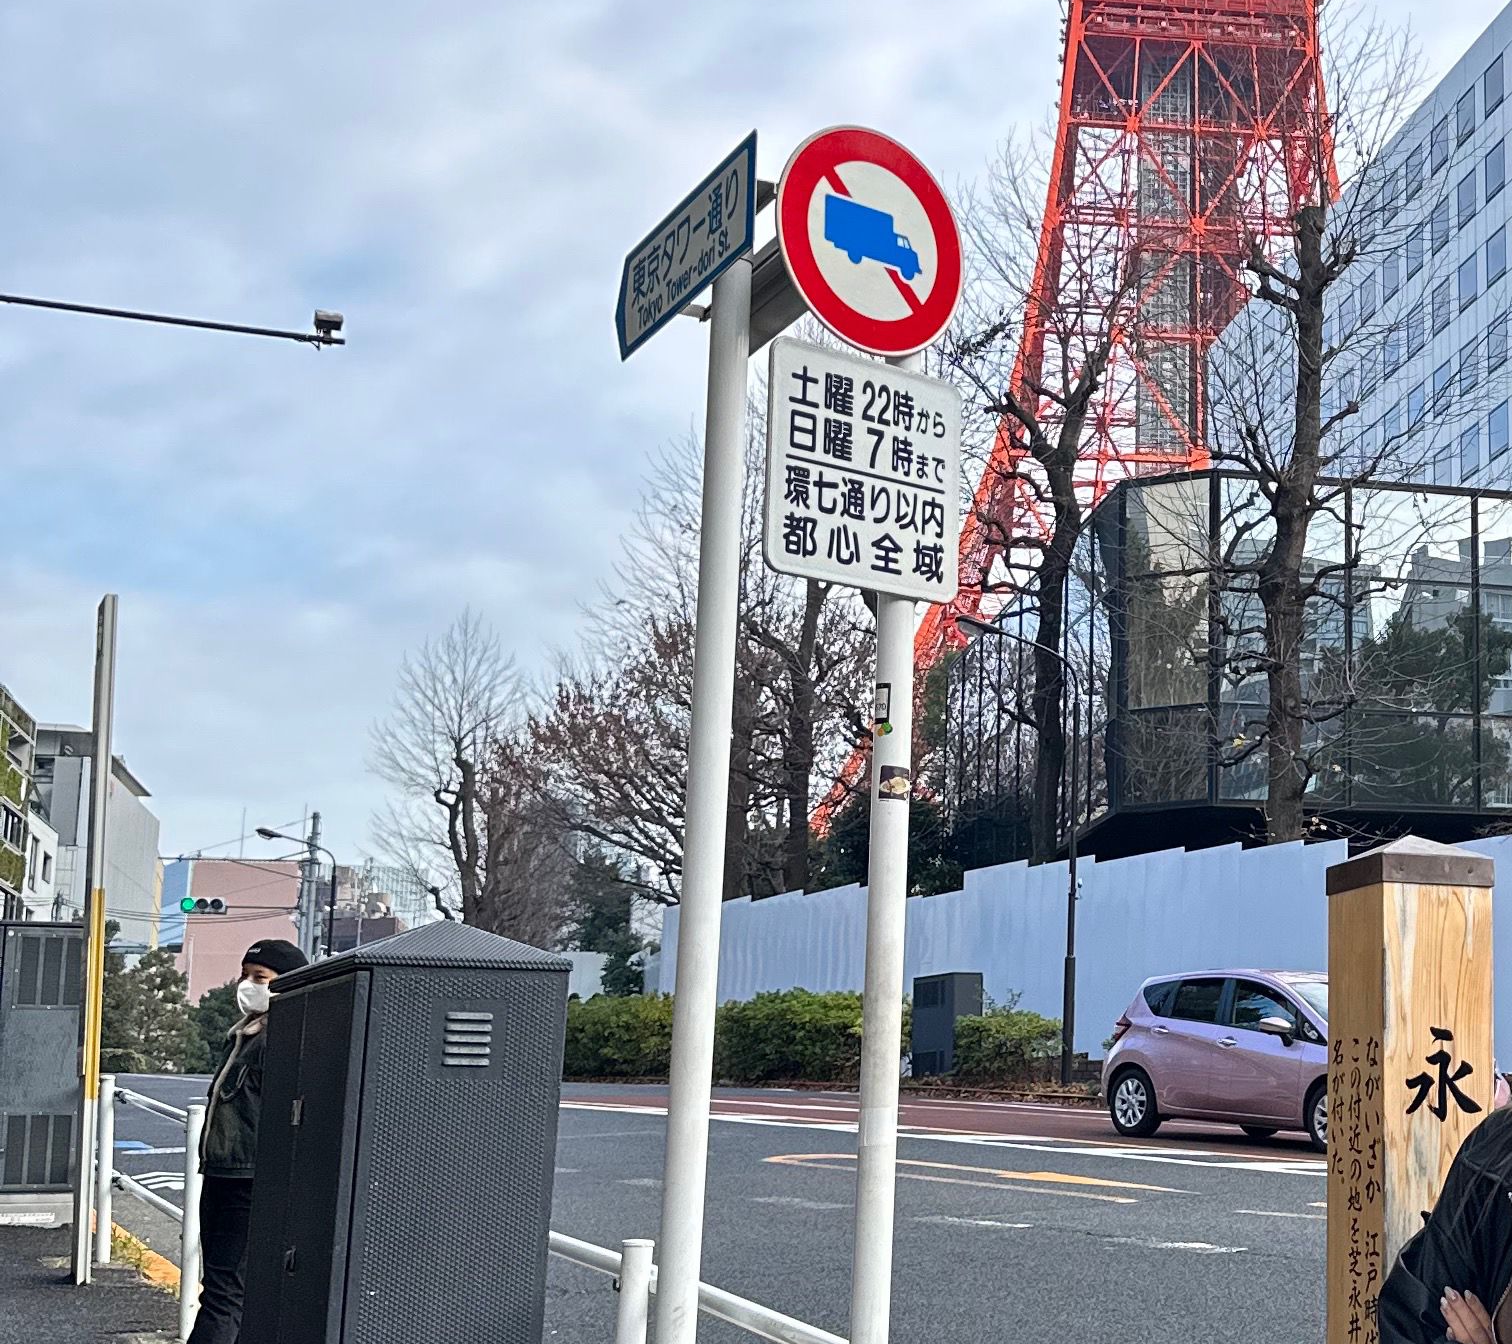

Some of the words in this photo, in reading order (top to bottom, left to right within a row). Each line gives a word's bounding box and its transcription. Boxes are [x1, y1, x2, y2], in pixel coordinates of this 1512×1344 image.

[632, 169, 738, 308] 東京タワー通り
[637, 293, 663, 329] Tokyo
[666, 238, 715, 304] Tower-dori
[719, 226, 731, 255] St.
[784, 464, 945, 539] 環七通り以内
[1331, 1039, 1345, 1184] 名が付いた。
[1365, 1036, 1381, 1204] ながいざか
